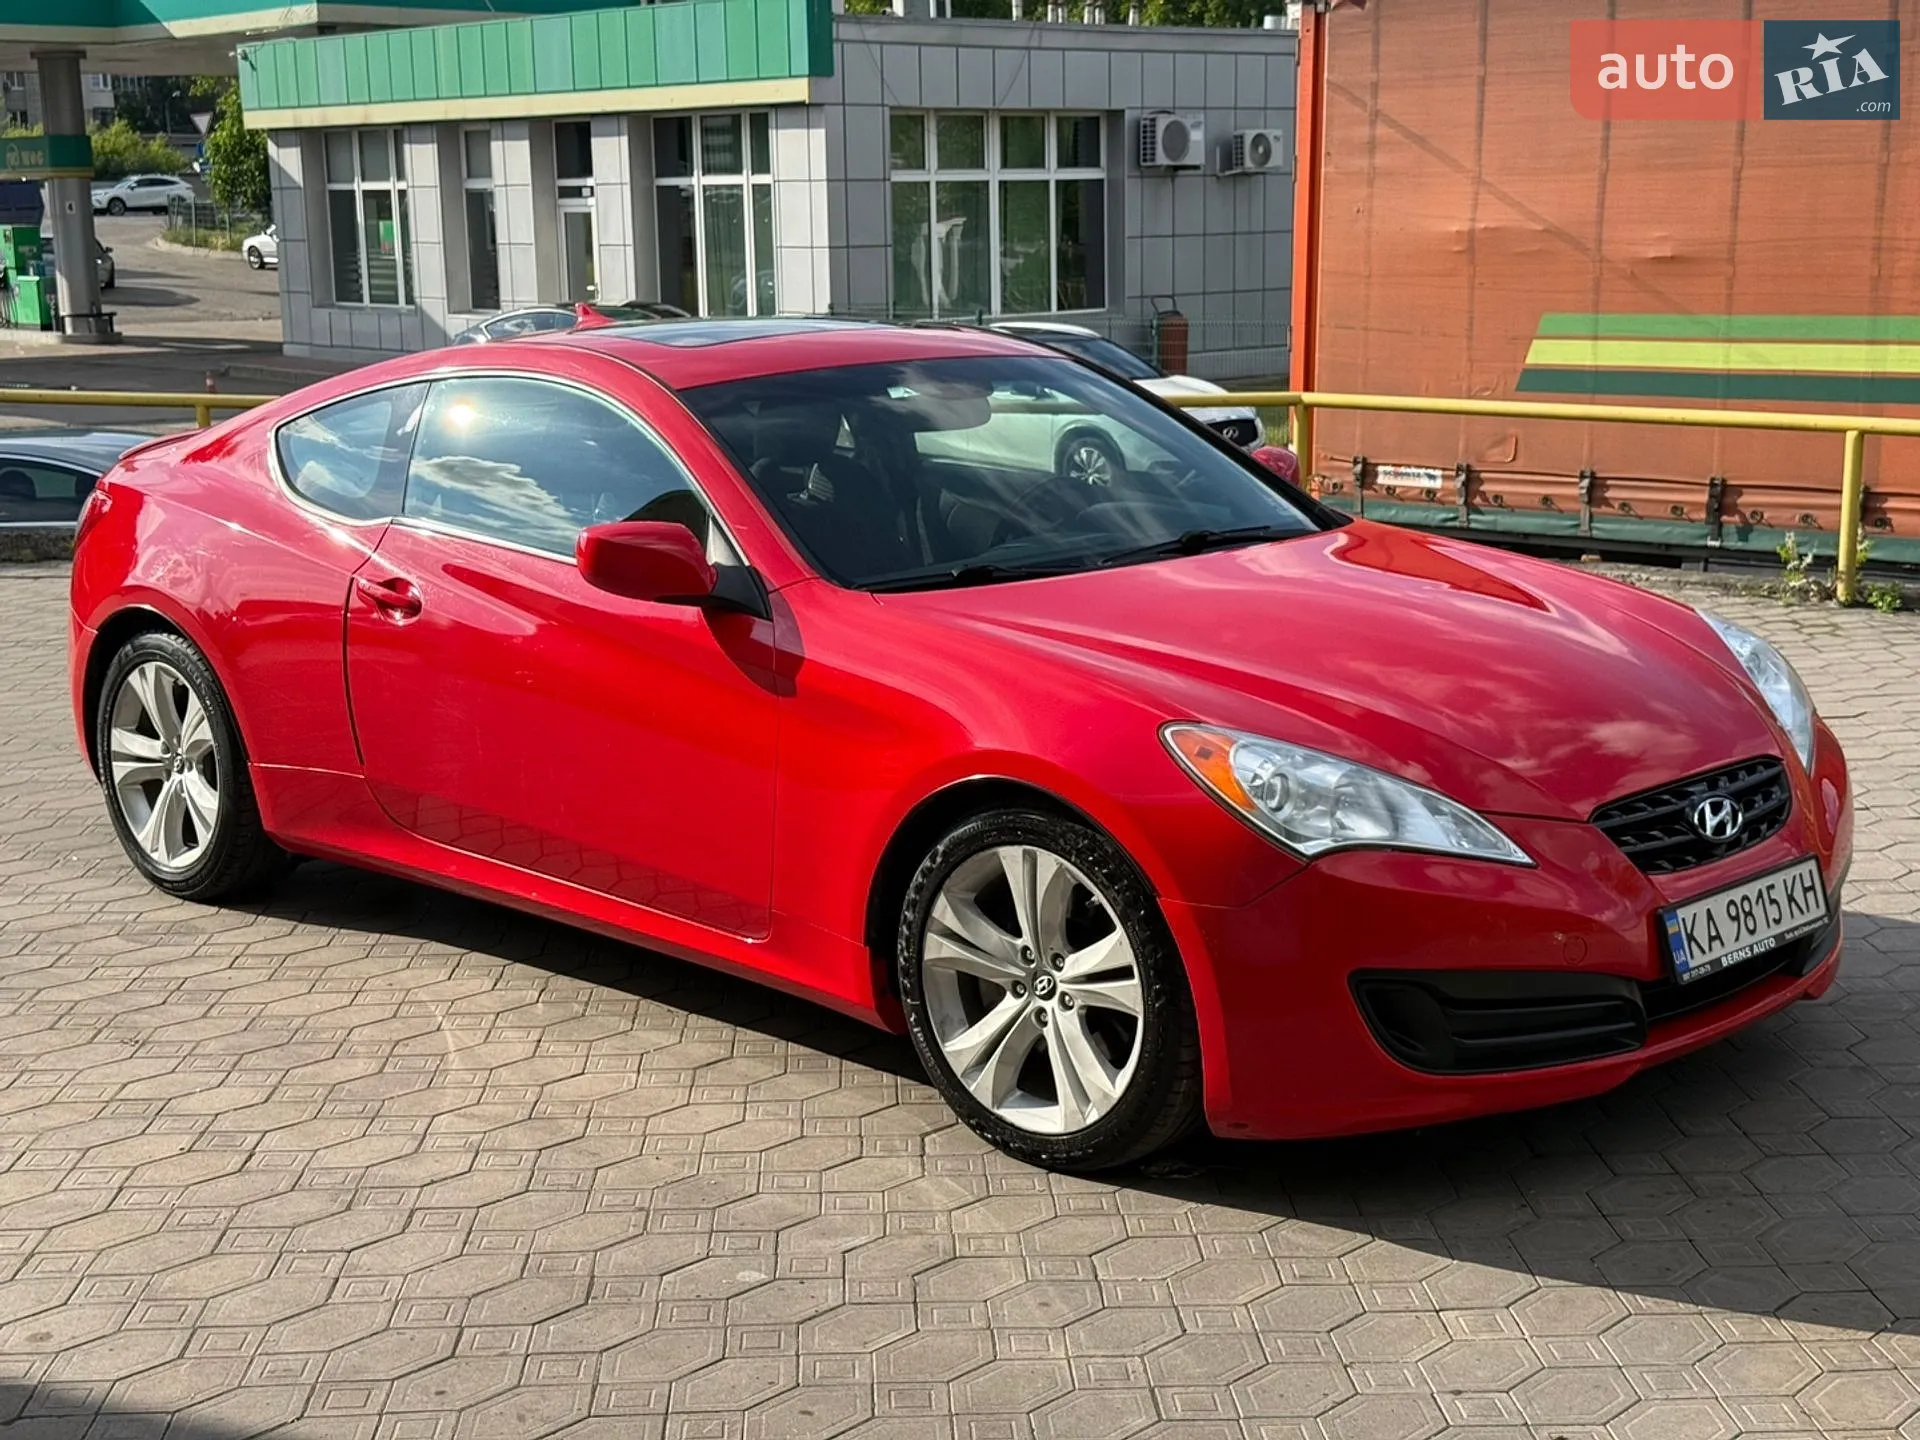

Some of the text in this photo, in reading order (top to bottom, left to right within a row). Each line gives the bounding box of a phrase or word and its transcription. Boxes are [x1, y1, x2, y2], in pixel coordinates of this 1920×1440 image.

[1682, 908, 1725, 960] KA
[1726, 884, 1782, 943] 9815
[1783, 869, 1820, 921] KH
[1672, 949, 1686, 964] UA
[1720, 937, 1776, 967] BERNS AUTO
